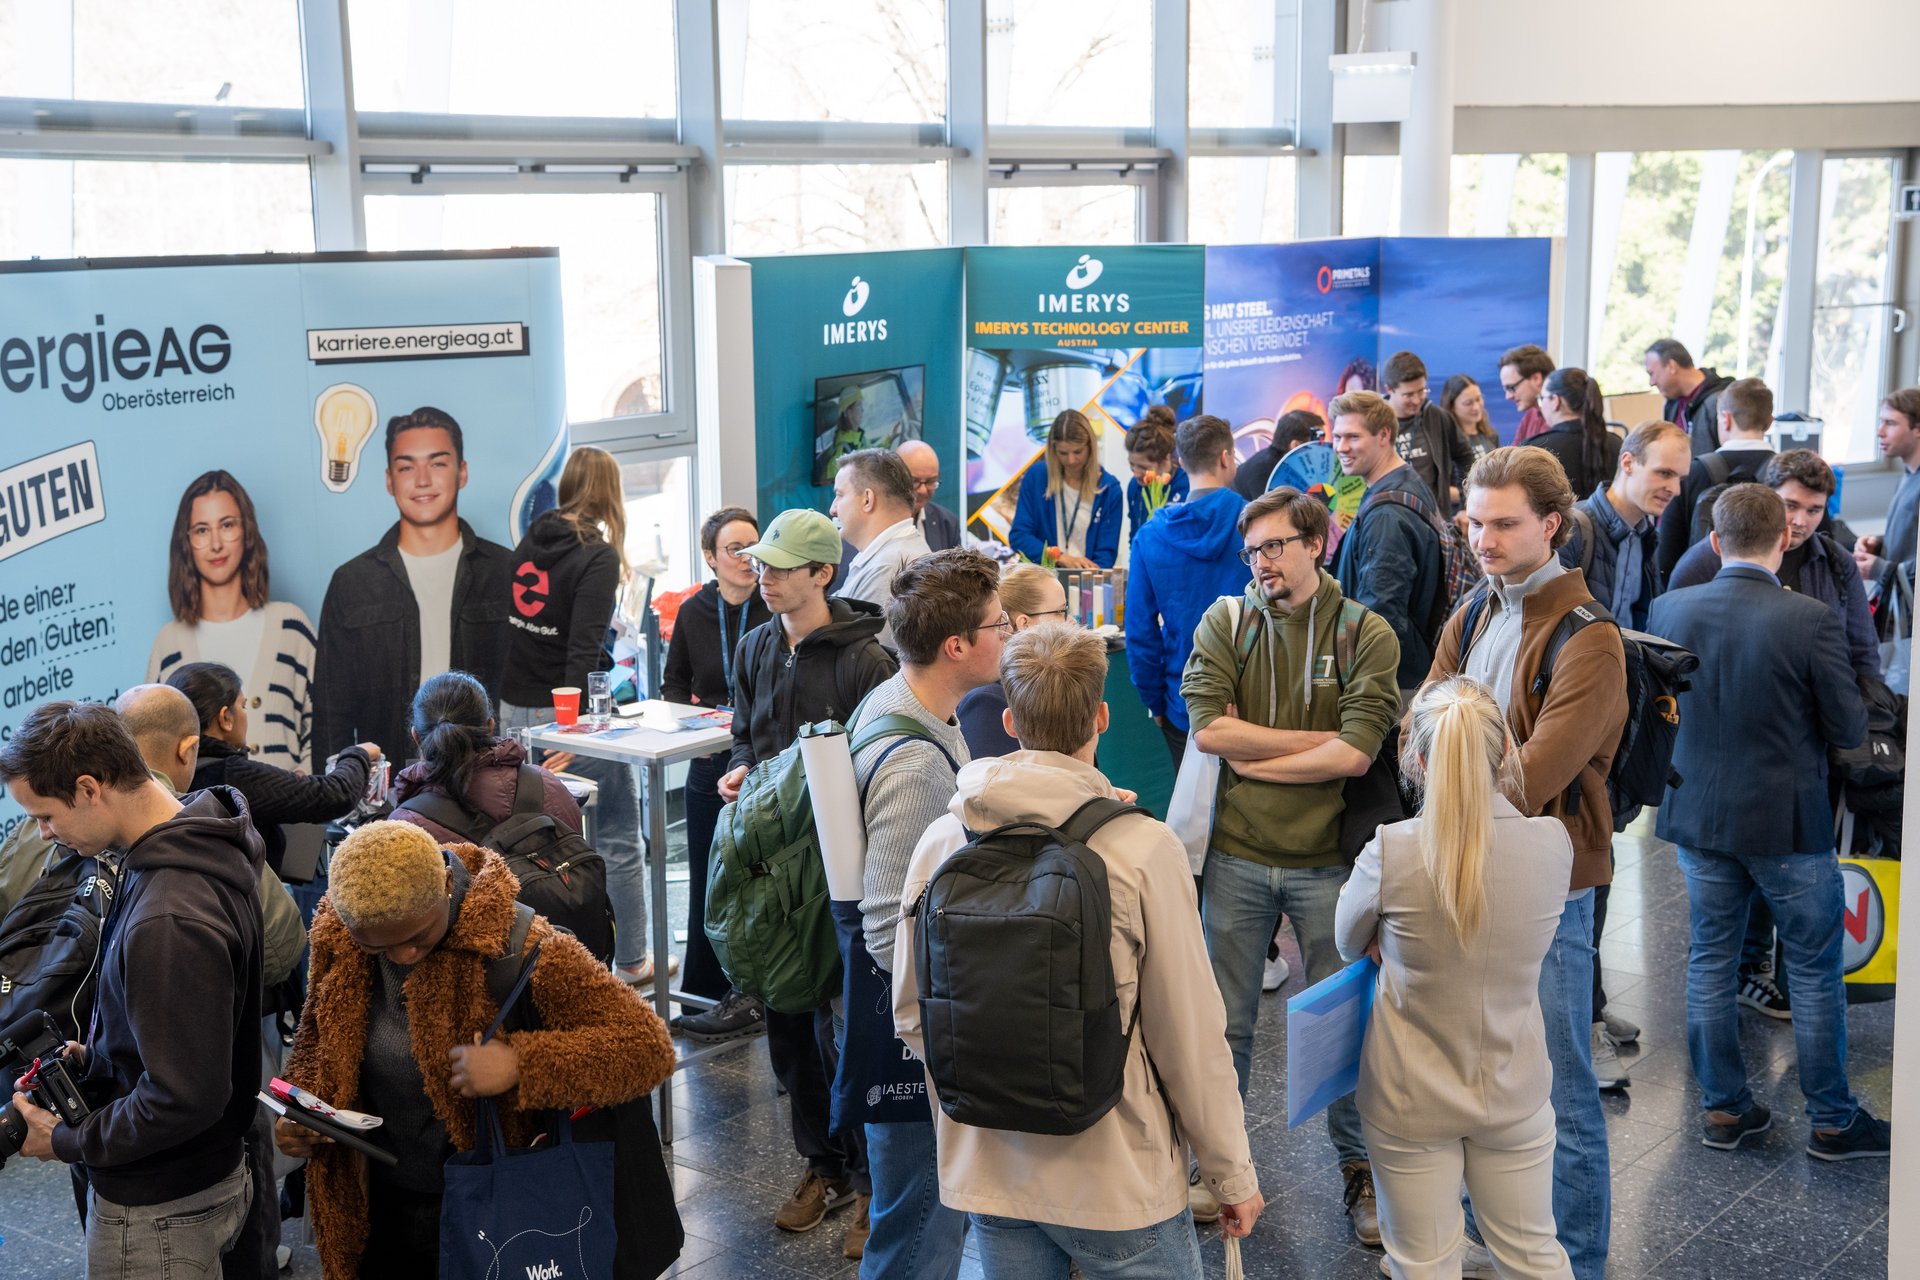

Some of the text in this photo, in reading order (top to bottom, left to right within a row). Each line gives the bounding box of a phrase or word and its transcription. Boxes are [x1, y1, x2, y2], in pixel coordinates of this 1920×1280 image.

[1038, 294, 1130, 313] IMERYS
[1212, 302, 1235, 319] HAT
[1236, 300, 1274, 318] STEEL.
[823, 318, 888, 346] IMERYS
[975, 321, 1190, 335] IMERYS TECHNOLOGY CENTER
[1217, 319, 1259, 337] UNSERE
[1260, 311, 1335, 333] LEIDENSCHAFT
[317, 328, 514, 352] karriere.energieag.at
[1057, 339, 1099, 347] AUSTRIA
[102, 383, 235, 411] Oberösterreich
[24, 583, 76, 615] eine:r
[1, 616, 109, 666] den Guten
[4, 665, 74, 709] arbeite
[882, 1082, 926, 1095] IAESTE
[525, 1259, 563, 1280] Work.
